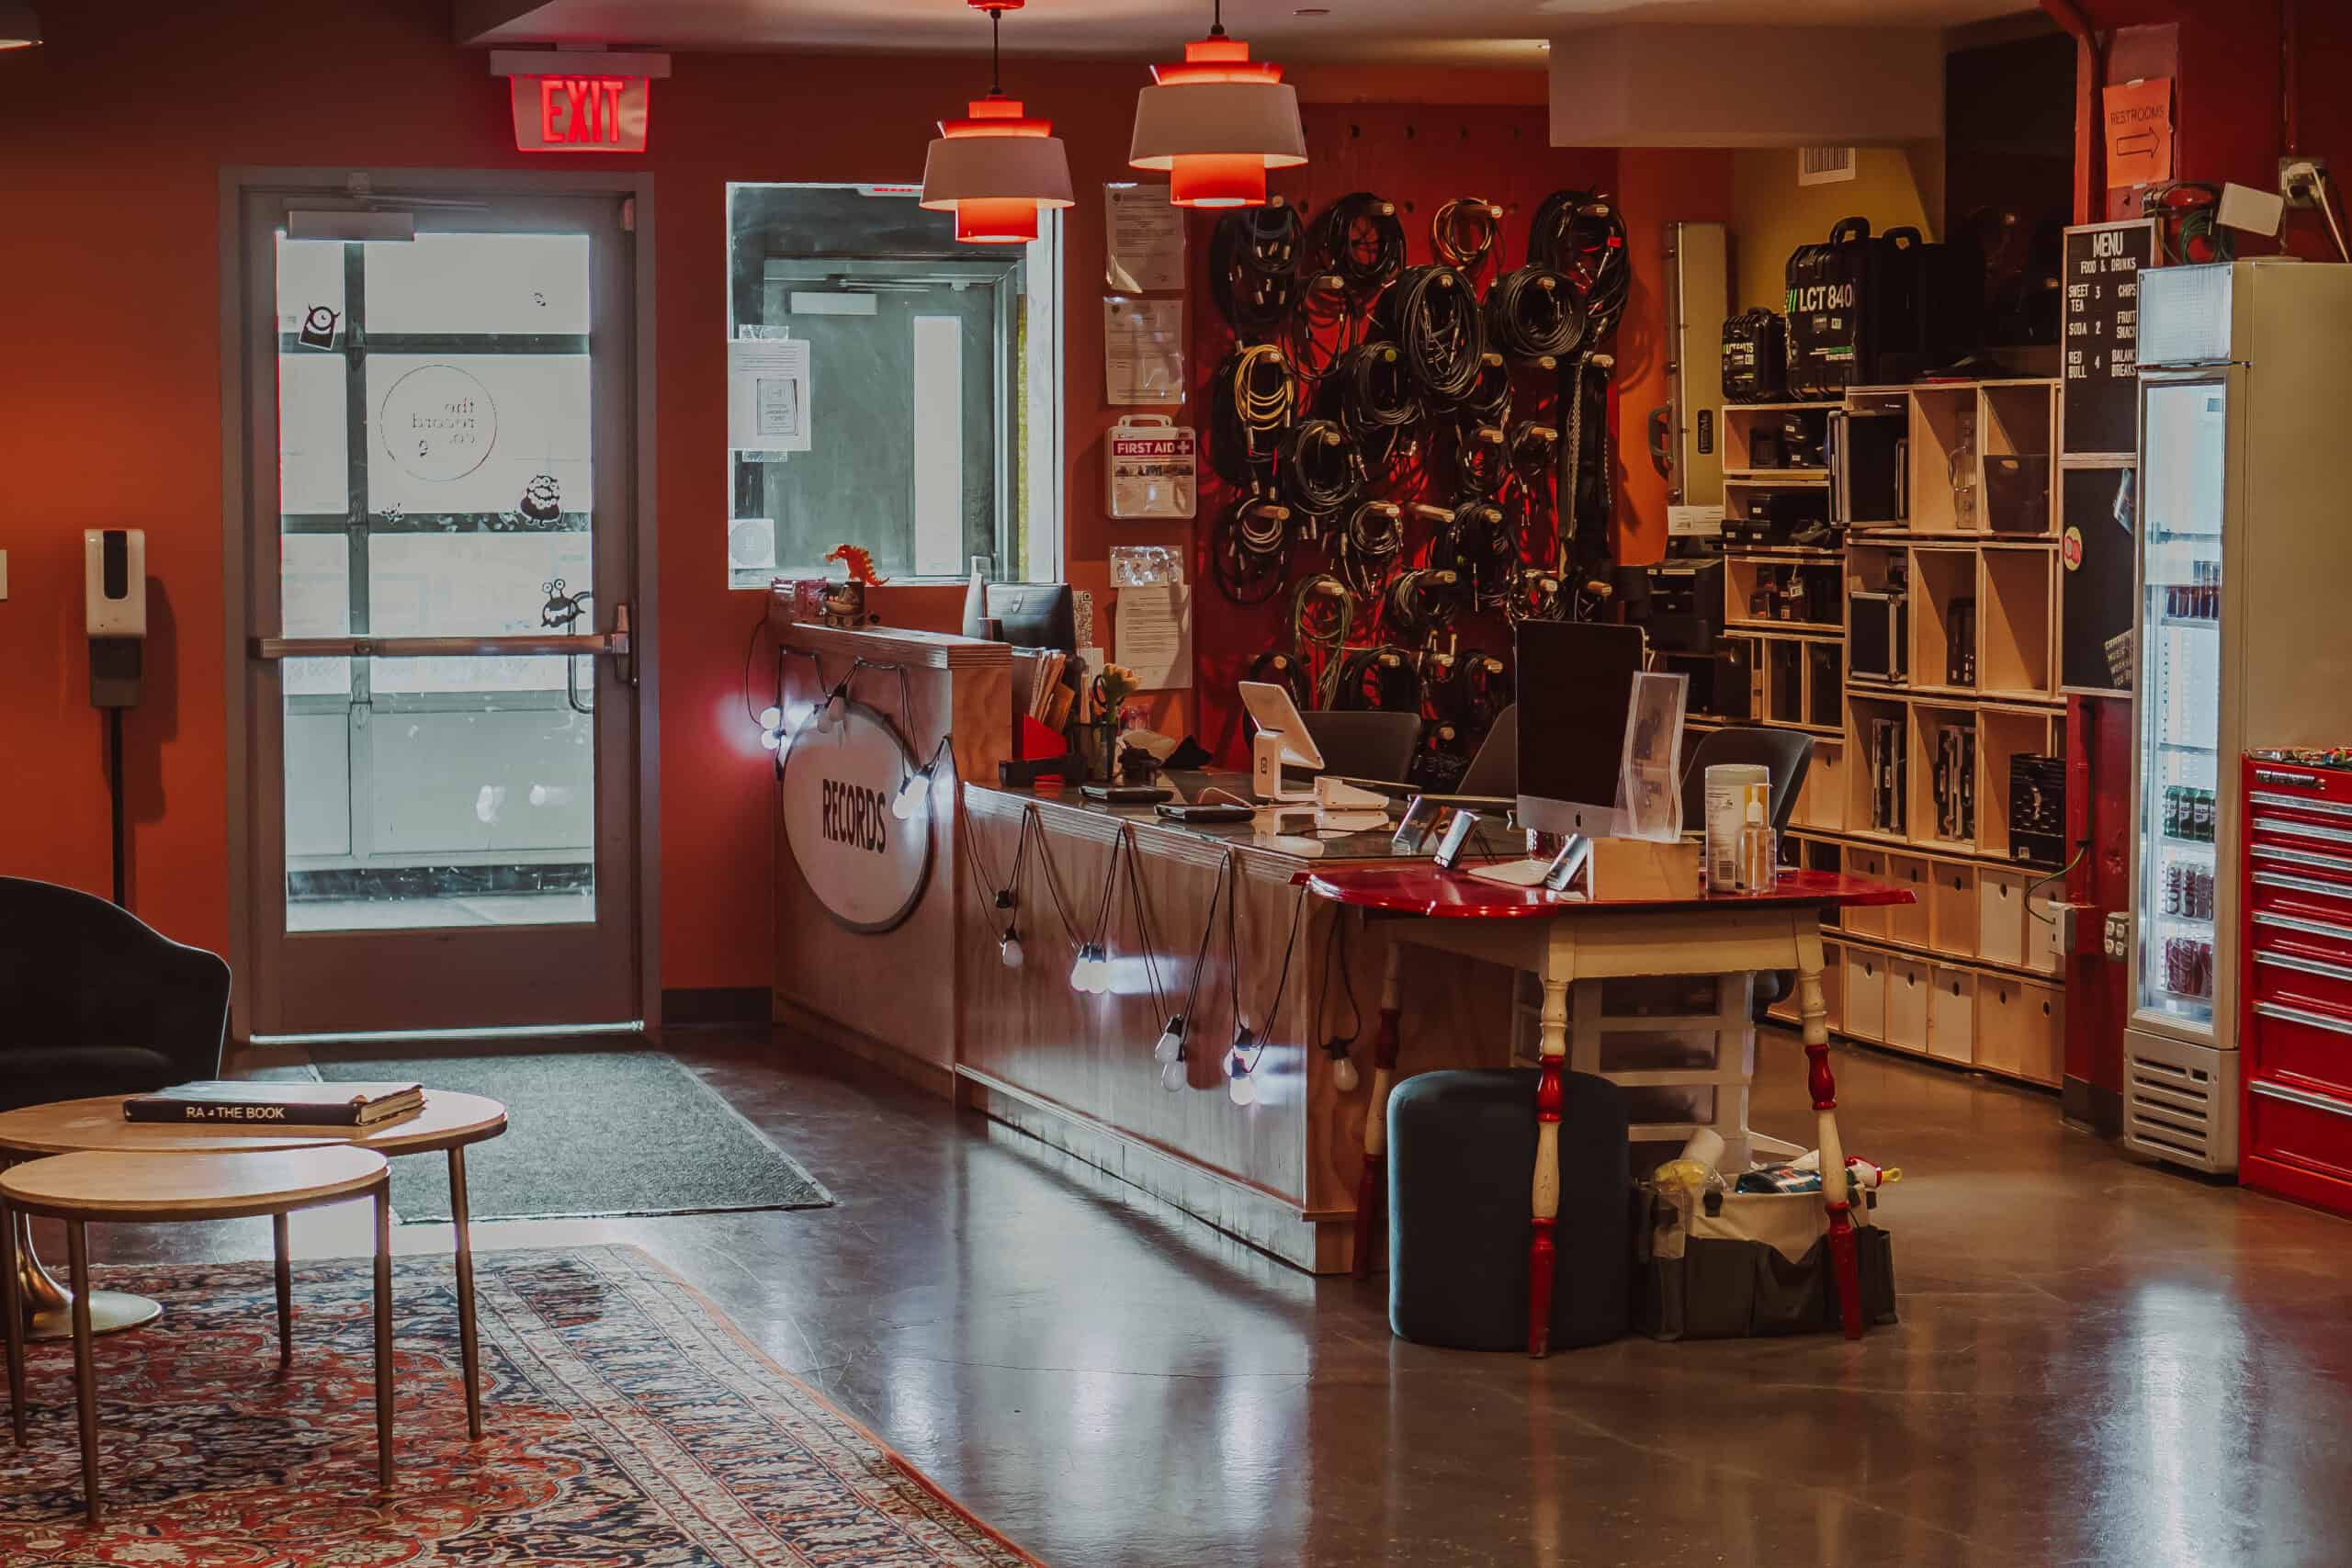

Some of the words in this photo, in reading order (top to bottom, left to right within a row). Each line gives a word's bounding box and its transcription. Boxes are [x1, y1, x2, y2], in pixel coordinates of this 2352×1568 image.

[540, 80, 625, 143] EXIT
[2110, 106, 2165, 125] RESTROOMS
[2093, 231, 2124, 257] MENU
[2080, 260, 2097, 275] FOOD
[2111, 257, 2137, 272] DRINKS
[1800, 286, 1826, 311] LCT
[1827, 284, 1853, 310] 840
[2068, 284, 2089, 299] SWEET
[2095, 286, 2101, 299] 3
[2118, 284, 2137, 299] CHIPS
[2071, 299, 2085, 312] TEA
[2117, 310, 2137, 324] FRUIT
[2068, 322, 2088, 336] SODA
[2095, 321, 2101, 335] 2
[2068, 351, 2083, 365] RED
[2094, 355, 2100, 369] 4
[2068, 365, 2087, 379] BULL
[1116, 442, 1153, 454] FIRST
[1154, 442, 1176, 454] AID
[822, 779, 887, 854] RECORDS
[186, 1106, 205, 1119] RA
[216, 1107, 243, 1119] THE
[246, 1107, 286, 1119] BOOK
